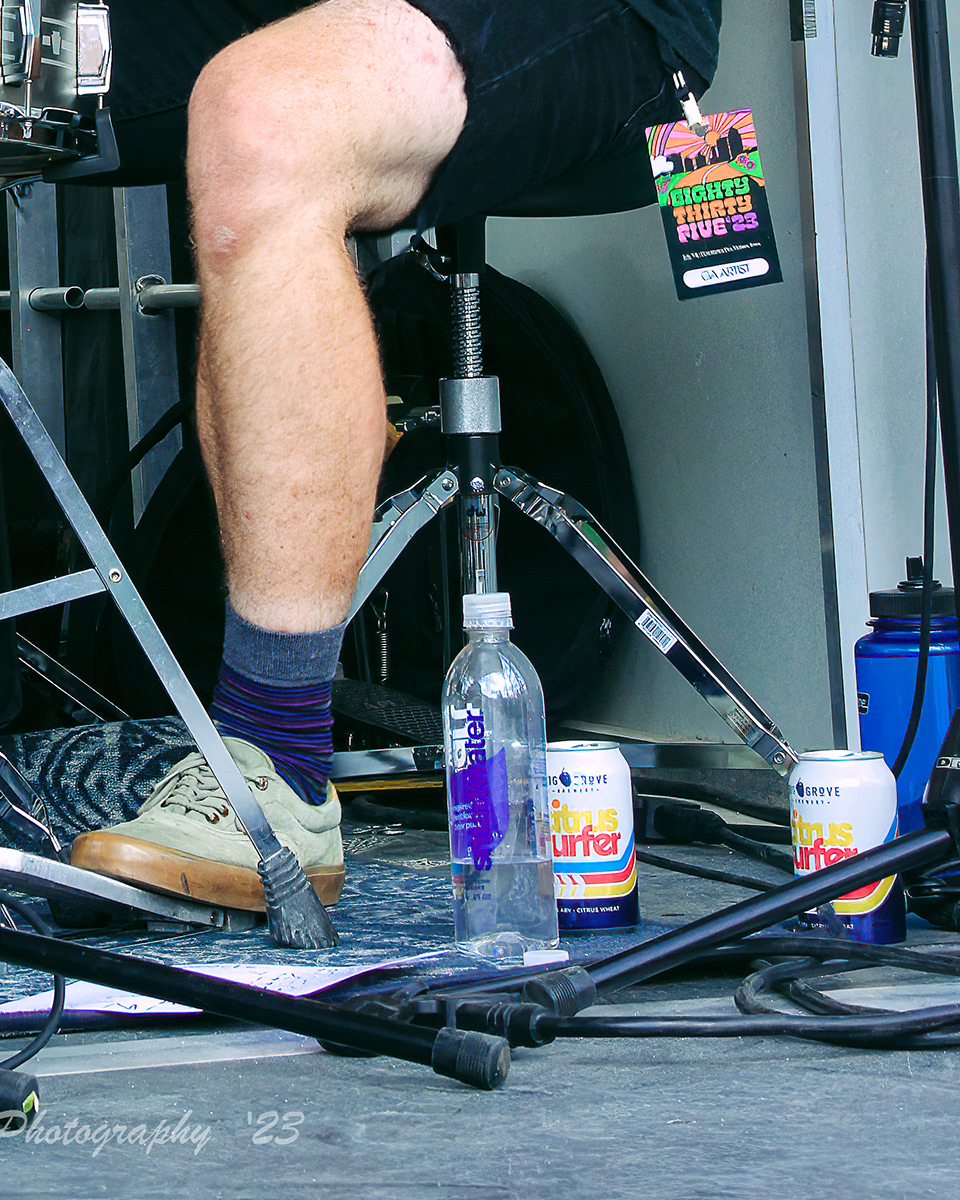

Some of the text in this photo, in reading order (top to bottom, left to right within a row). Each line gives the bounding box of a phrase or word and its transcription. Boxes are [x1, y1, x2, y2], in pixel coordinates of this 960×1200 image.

[669, 176, 751, 207] EIGHTY
[673, 194, 753, 225] THIRTY
[676, 217, 728, 243] FIVE
[805, 786, 841, 797] GROVE
[550, 799, 618, 834] itrus
[552, 824, 622, 858] urfer
[794, 837, 858, 871] urfe
[576, 906, 599, 914] CITRUS
[599, 905, 620, 913] WHEAT
